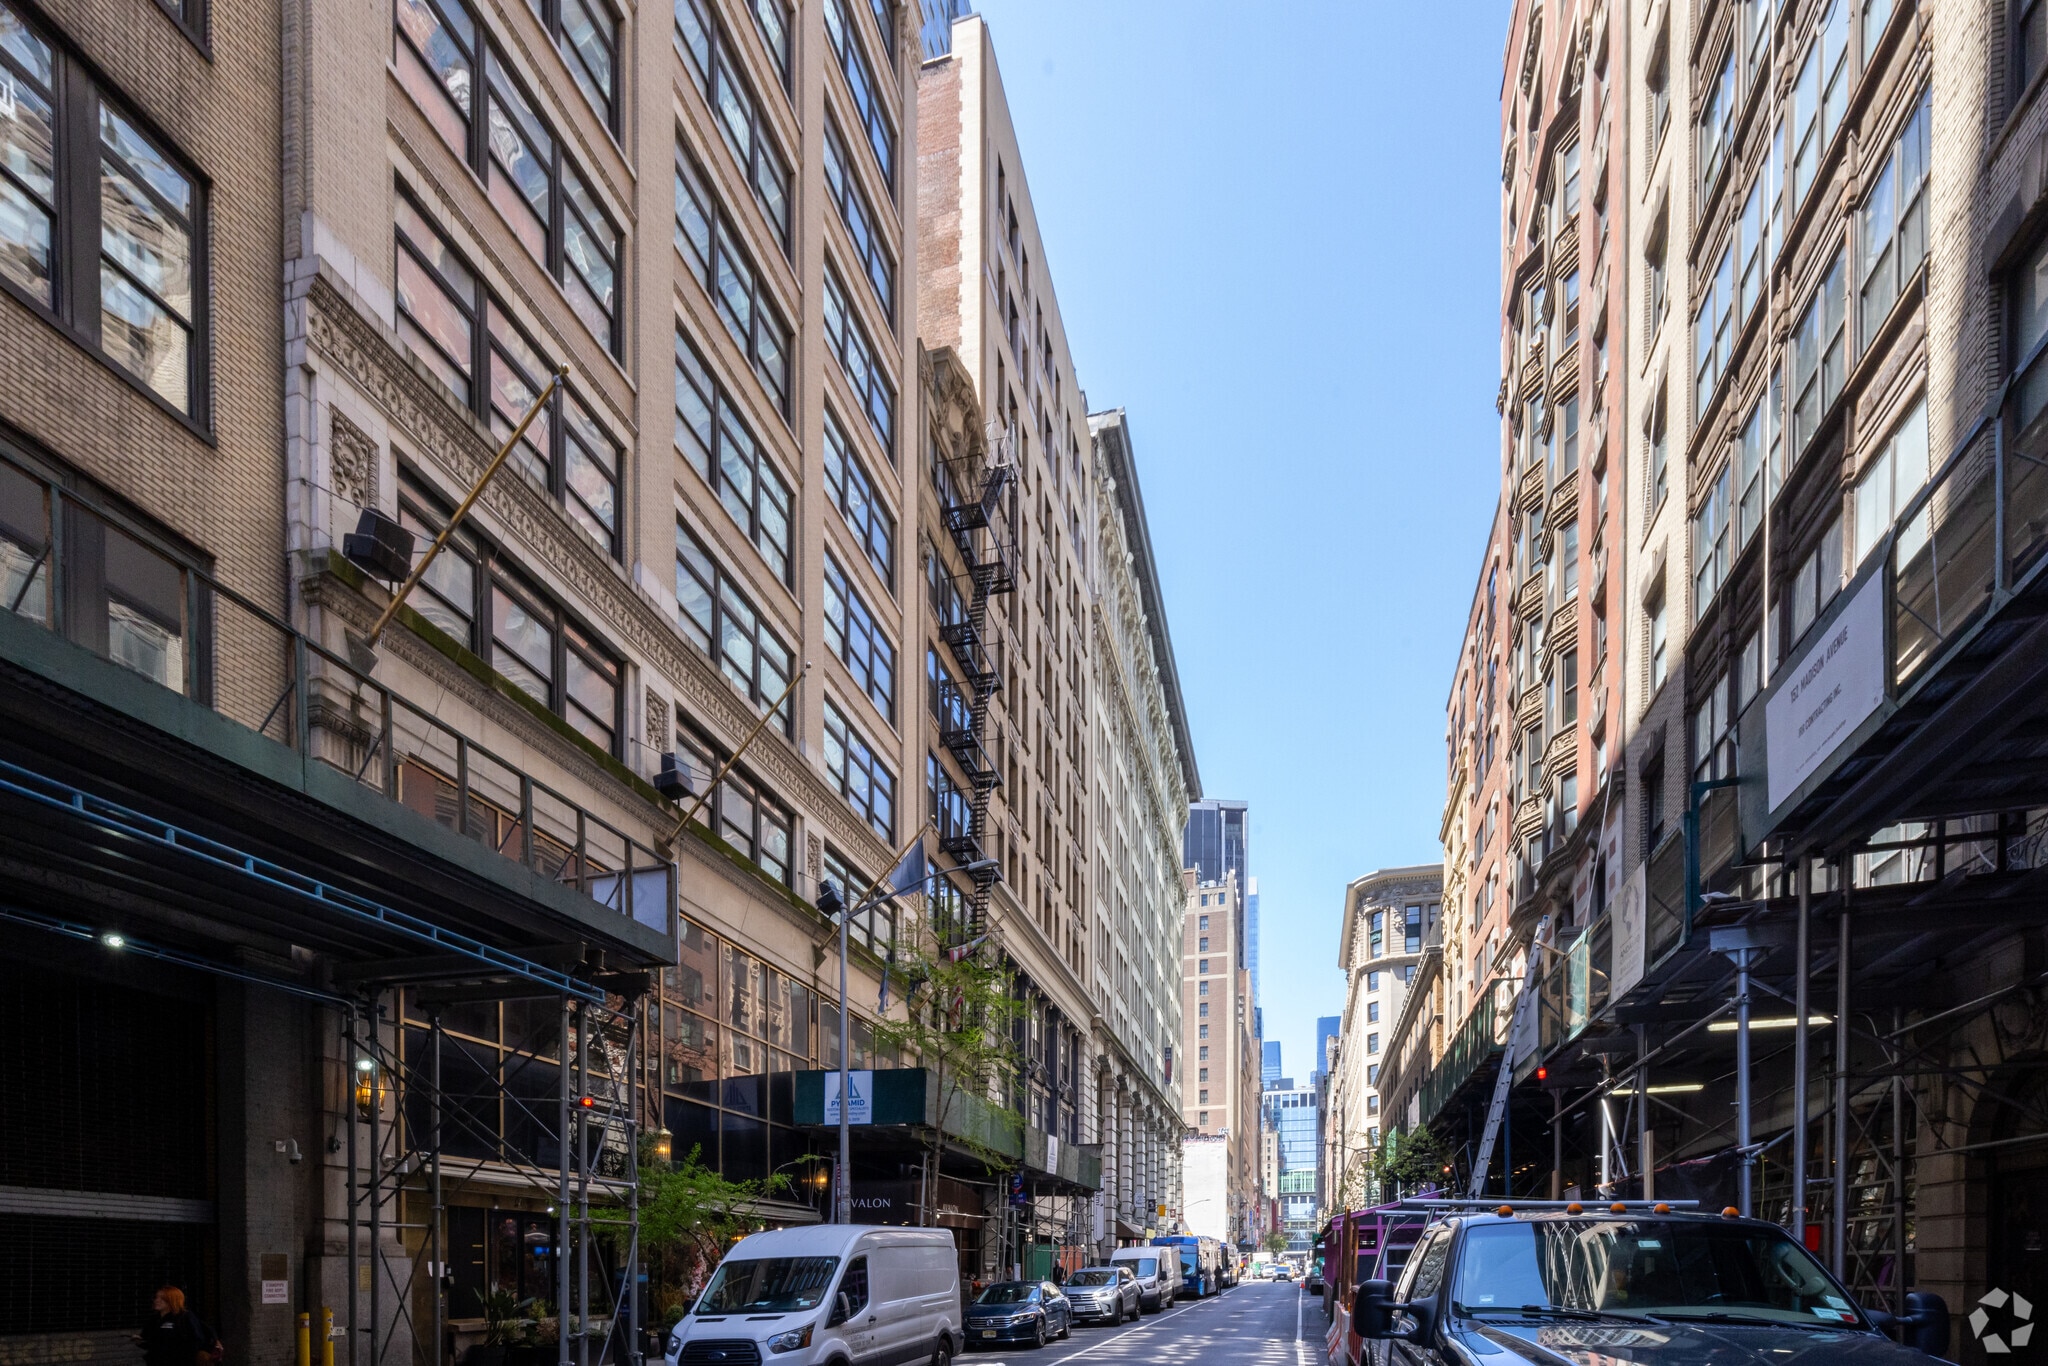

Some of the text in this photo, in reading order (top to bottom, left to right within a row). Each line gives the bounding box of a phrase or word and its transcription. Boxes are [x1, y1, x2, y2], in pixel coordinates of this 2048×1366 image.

[1800, 654, 1825, 693] MADISON
[1825, 625, 1849, 664] AVENUE
[831, 1099, 865, 1108] PYAMID
[850, 1197, 891, 1209] VALON
